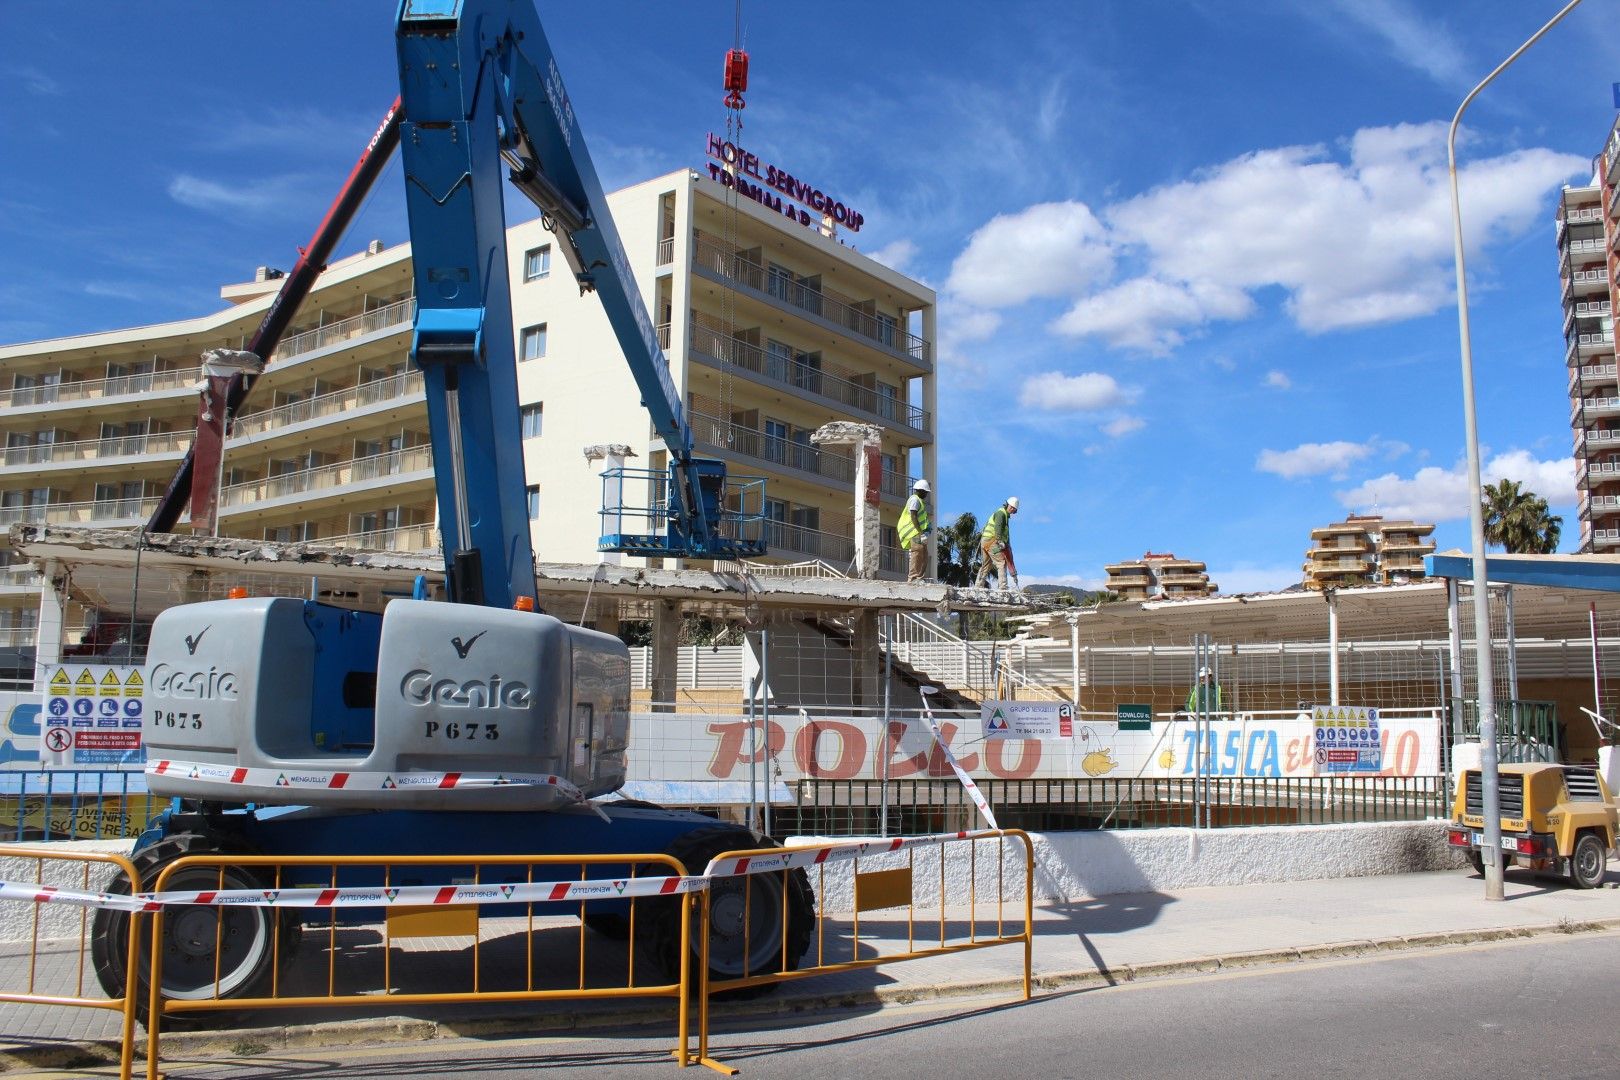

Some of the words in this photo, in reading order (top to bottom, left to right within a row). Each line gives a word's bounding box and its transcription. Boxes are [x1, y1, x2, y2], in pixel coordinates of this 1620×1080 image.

[366, 110, 395, 152] TOMAS
[705, 132, 762, 180] HOTEL
[766, 164, 864, 232] SERVIGROUP
[150, 662, 238, 701] Genie
[400, 668, 531, 709] Genie
[154, 710, 203, 729] P673
[425, 721, 499, 740] P673
[706, 719, 1042, 780] POLLO
[1183, 729, 1281, 777] TASCA
